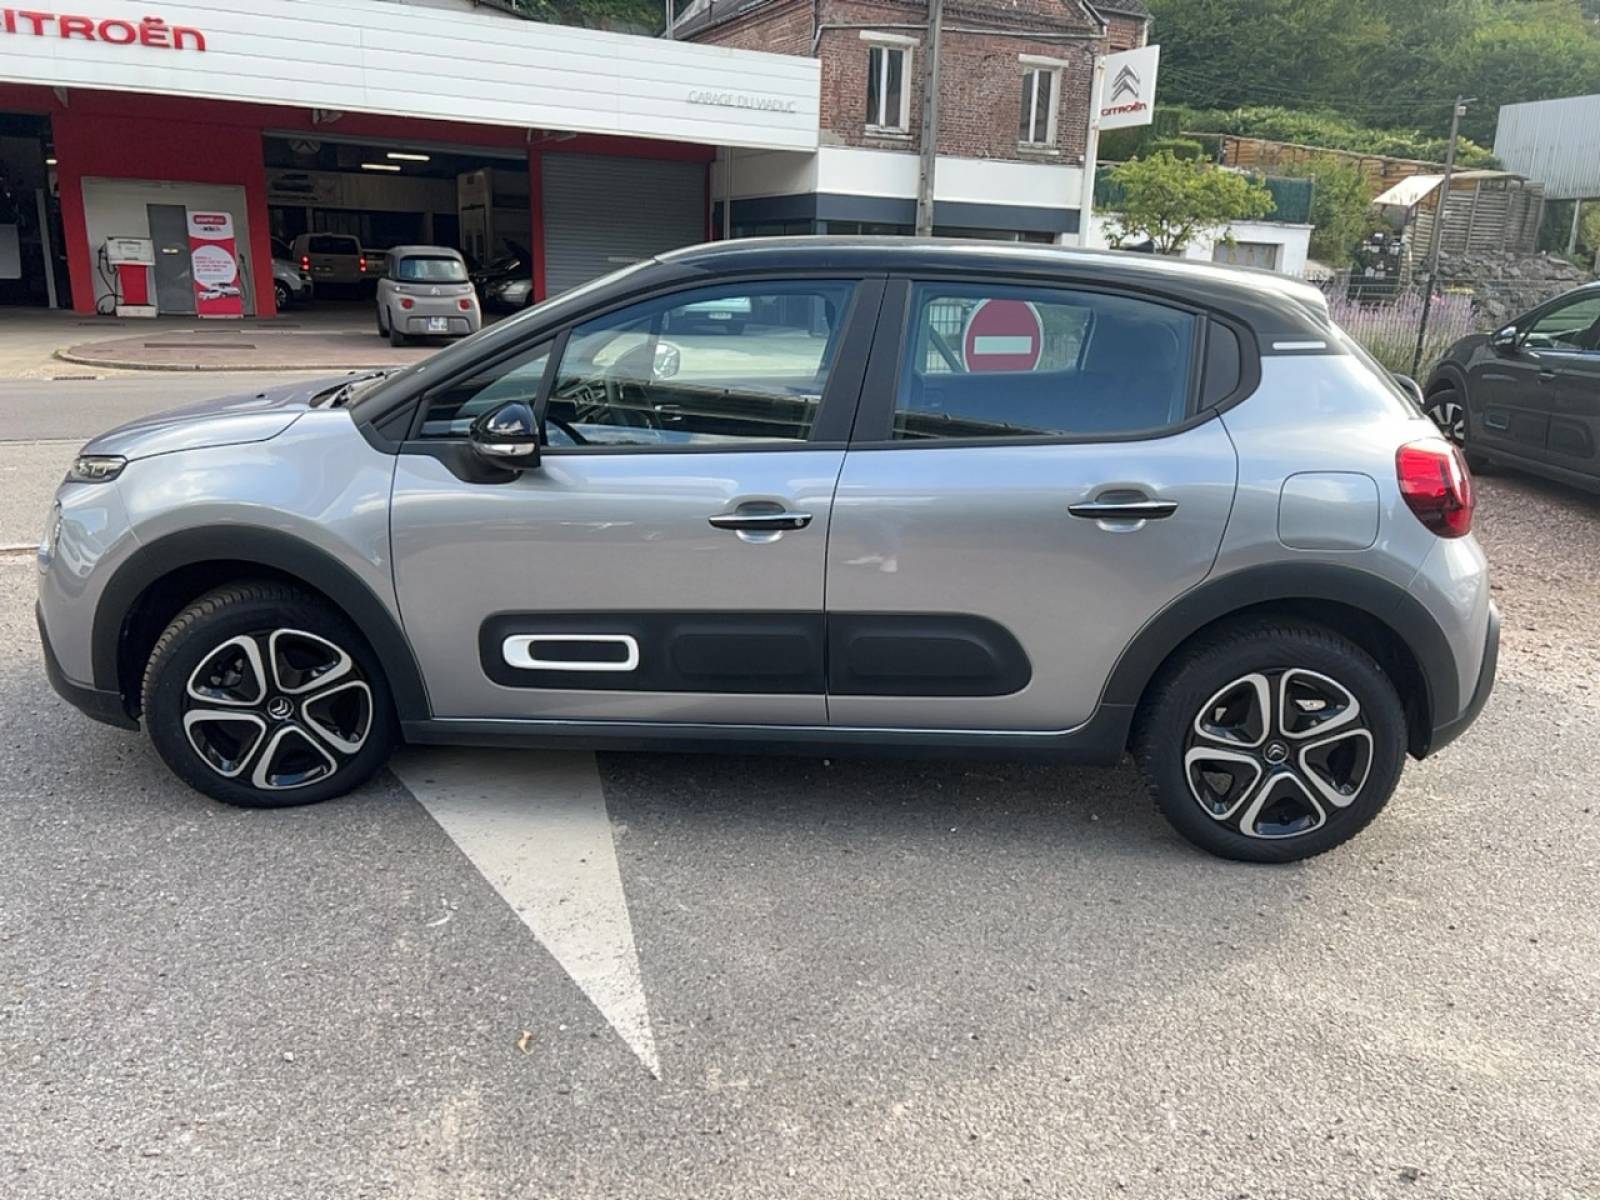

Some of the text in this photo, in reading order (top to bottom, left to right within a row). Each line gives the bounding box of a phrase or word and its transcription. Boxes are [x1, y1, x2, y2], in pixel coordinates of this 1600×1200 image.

[0, 9, 206, 52] ITROËn
[688, 90, 797, 113] GARAGE DU VIADUC
